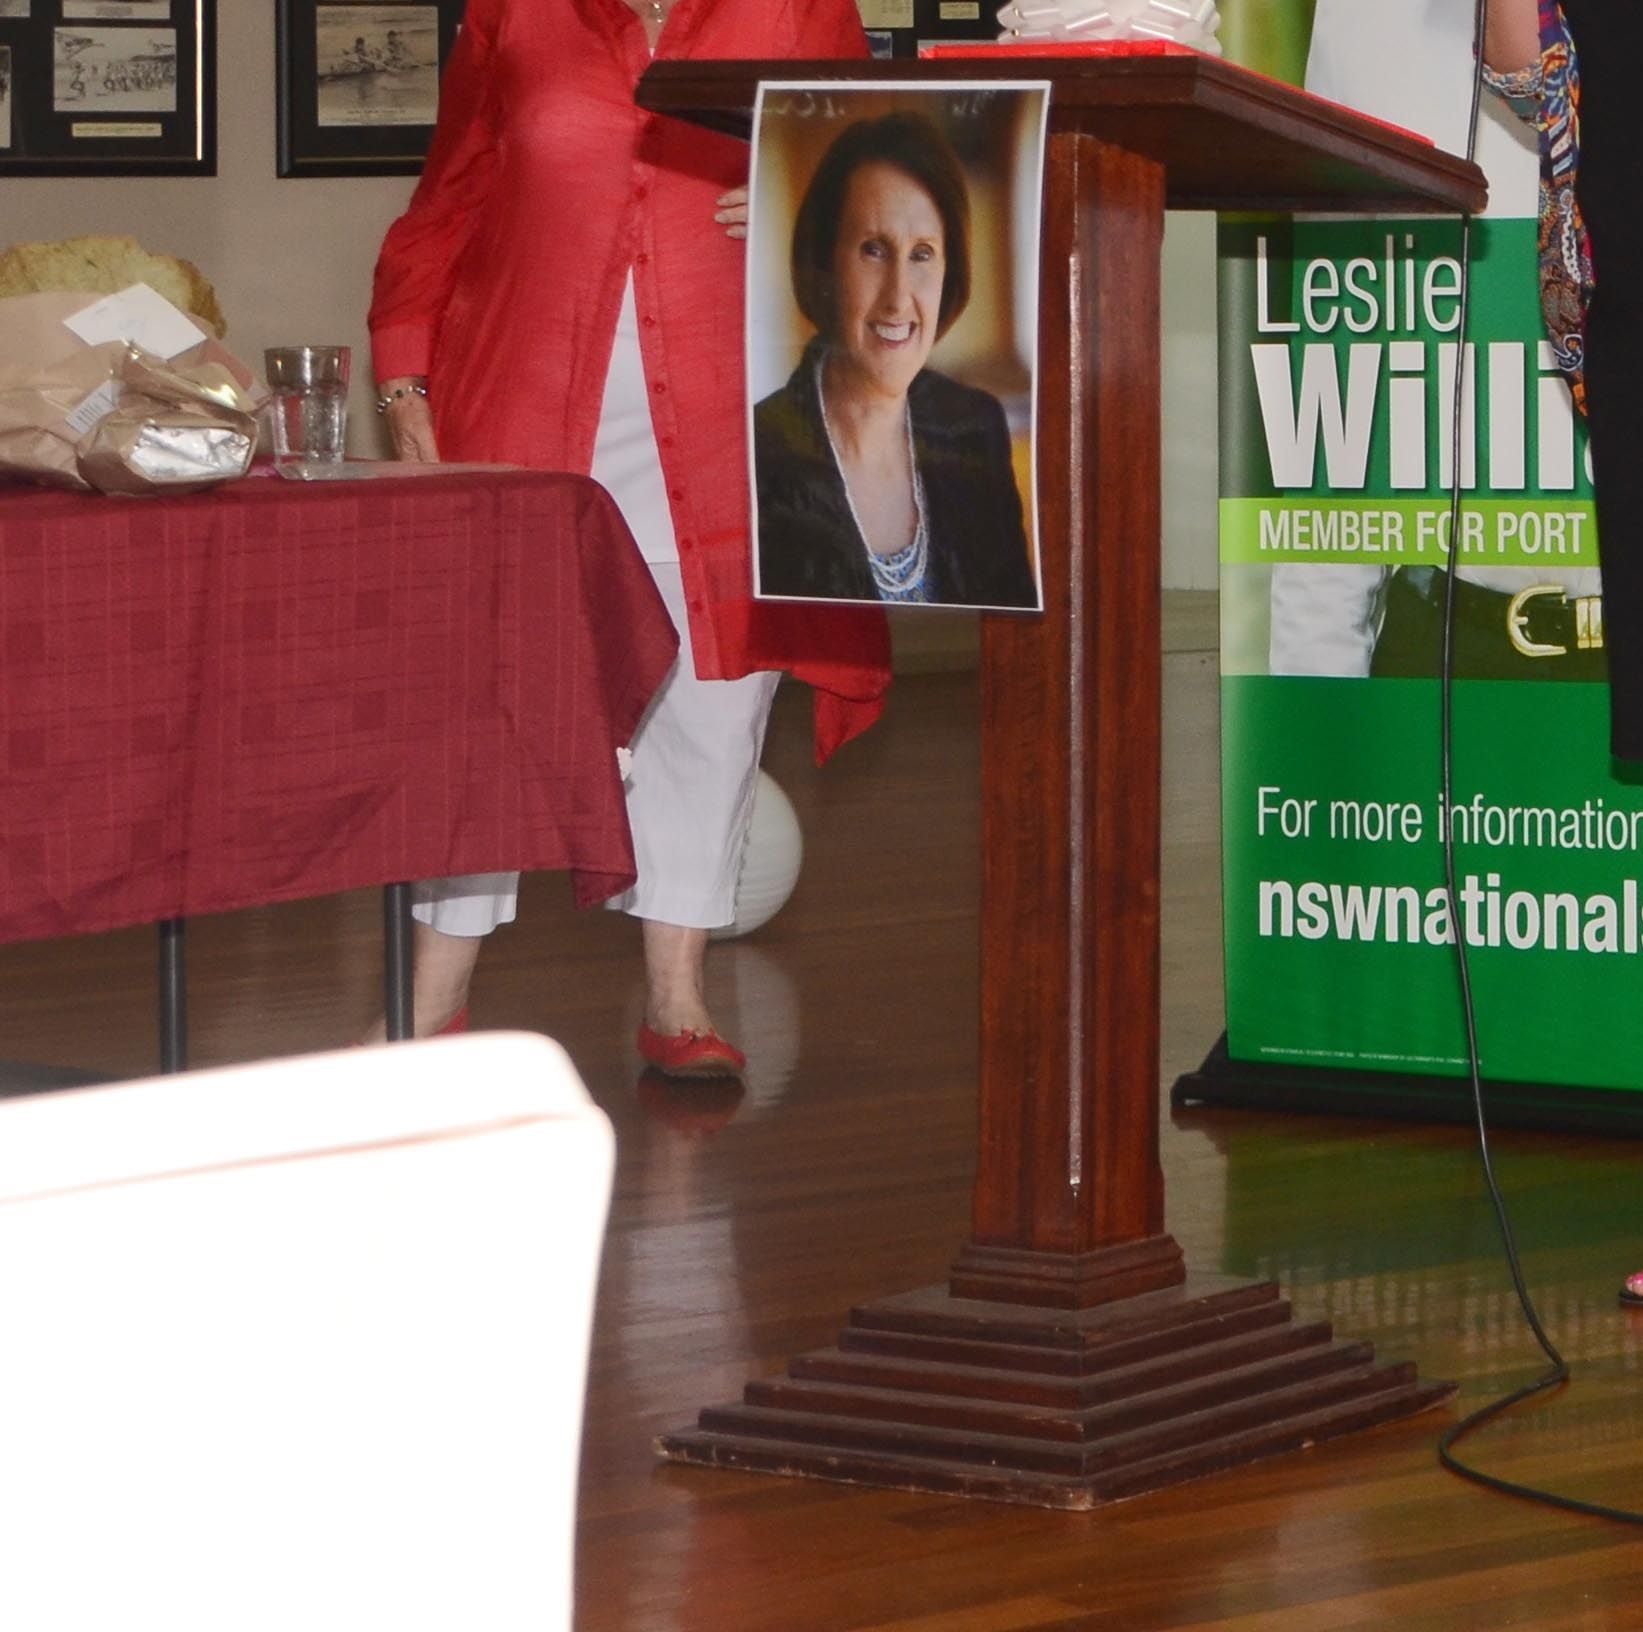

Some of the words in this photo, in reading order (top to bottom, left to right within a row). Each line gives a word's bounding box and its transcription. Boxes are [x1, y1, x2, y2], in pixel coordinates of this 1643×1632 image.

[1256, 234, 1464, 333] Leslie
[1258, 509, 1404, 552] MEMBER
[1417, 511, 1486, 554] FOR
[1497, 512, 1588, 555] PORT
[1256, 786, 1317, 838] For
[1329, 798, 1423, 843] more
